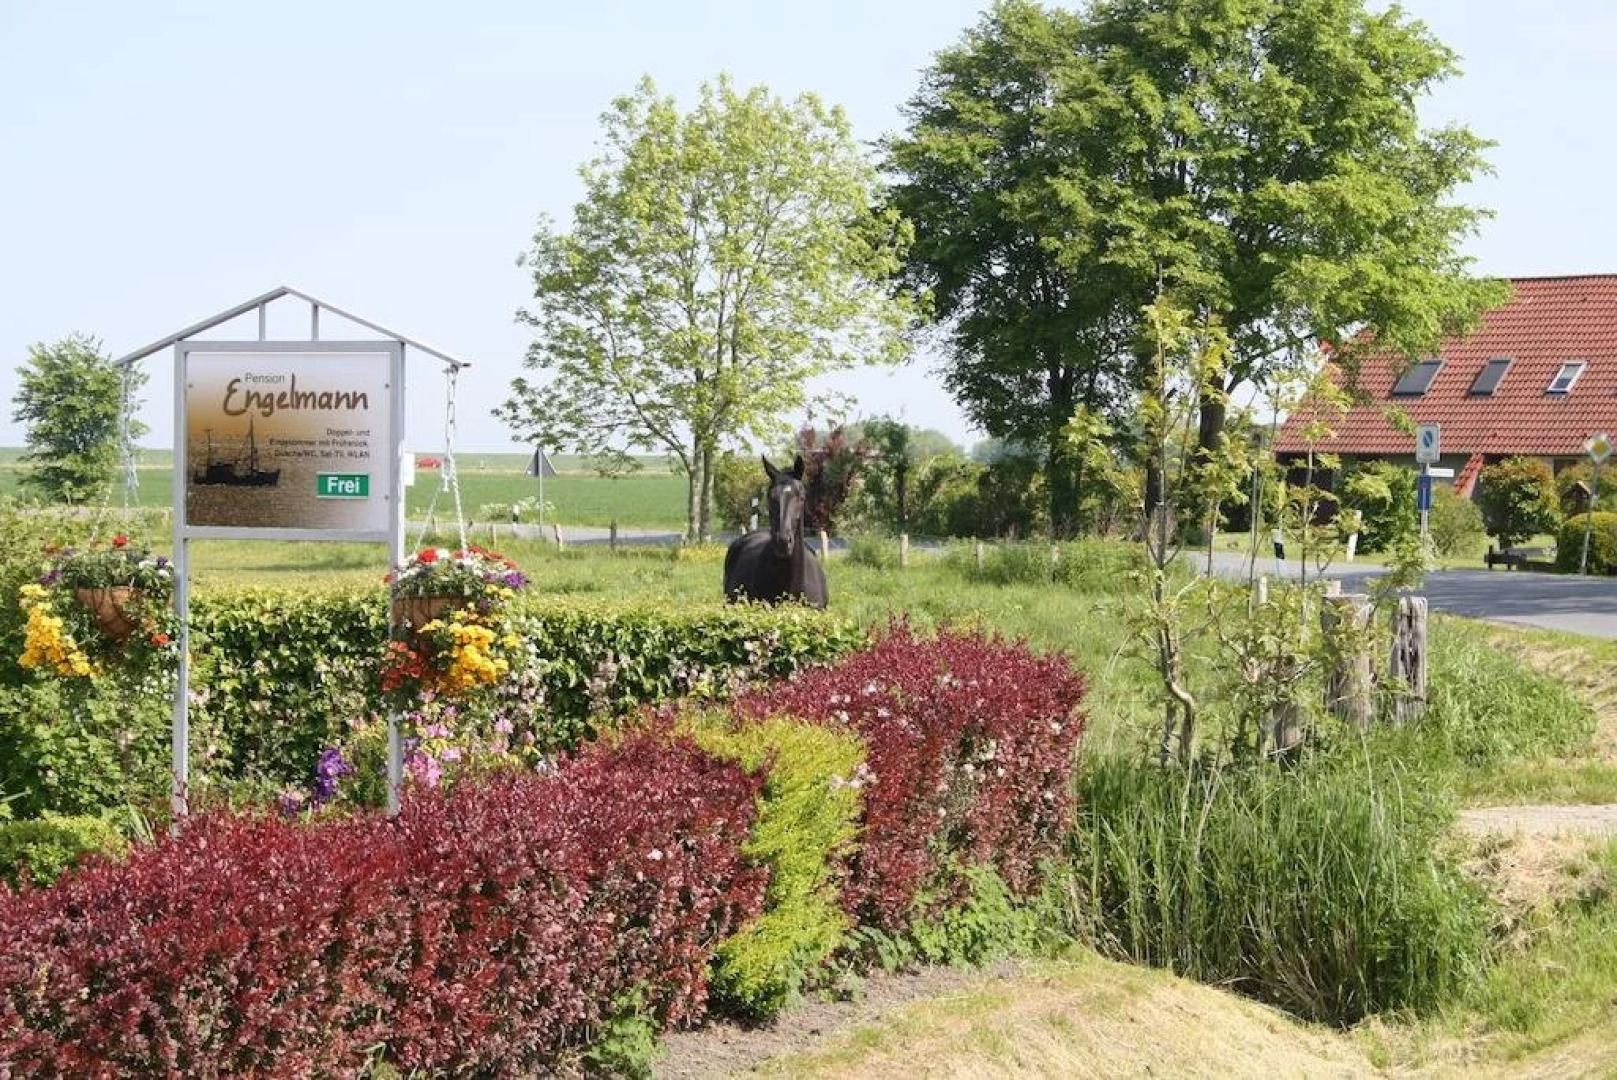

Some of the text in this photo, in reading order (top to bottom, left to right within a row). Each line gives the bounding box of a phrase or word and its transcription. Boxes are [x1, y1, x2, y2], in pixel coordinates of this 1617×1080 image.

[245, 372, 285, 384] Pension
[223, 372, 369, 417] Engelmann
[326, 477, 360, 494] Frei
